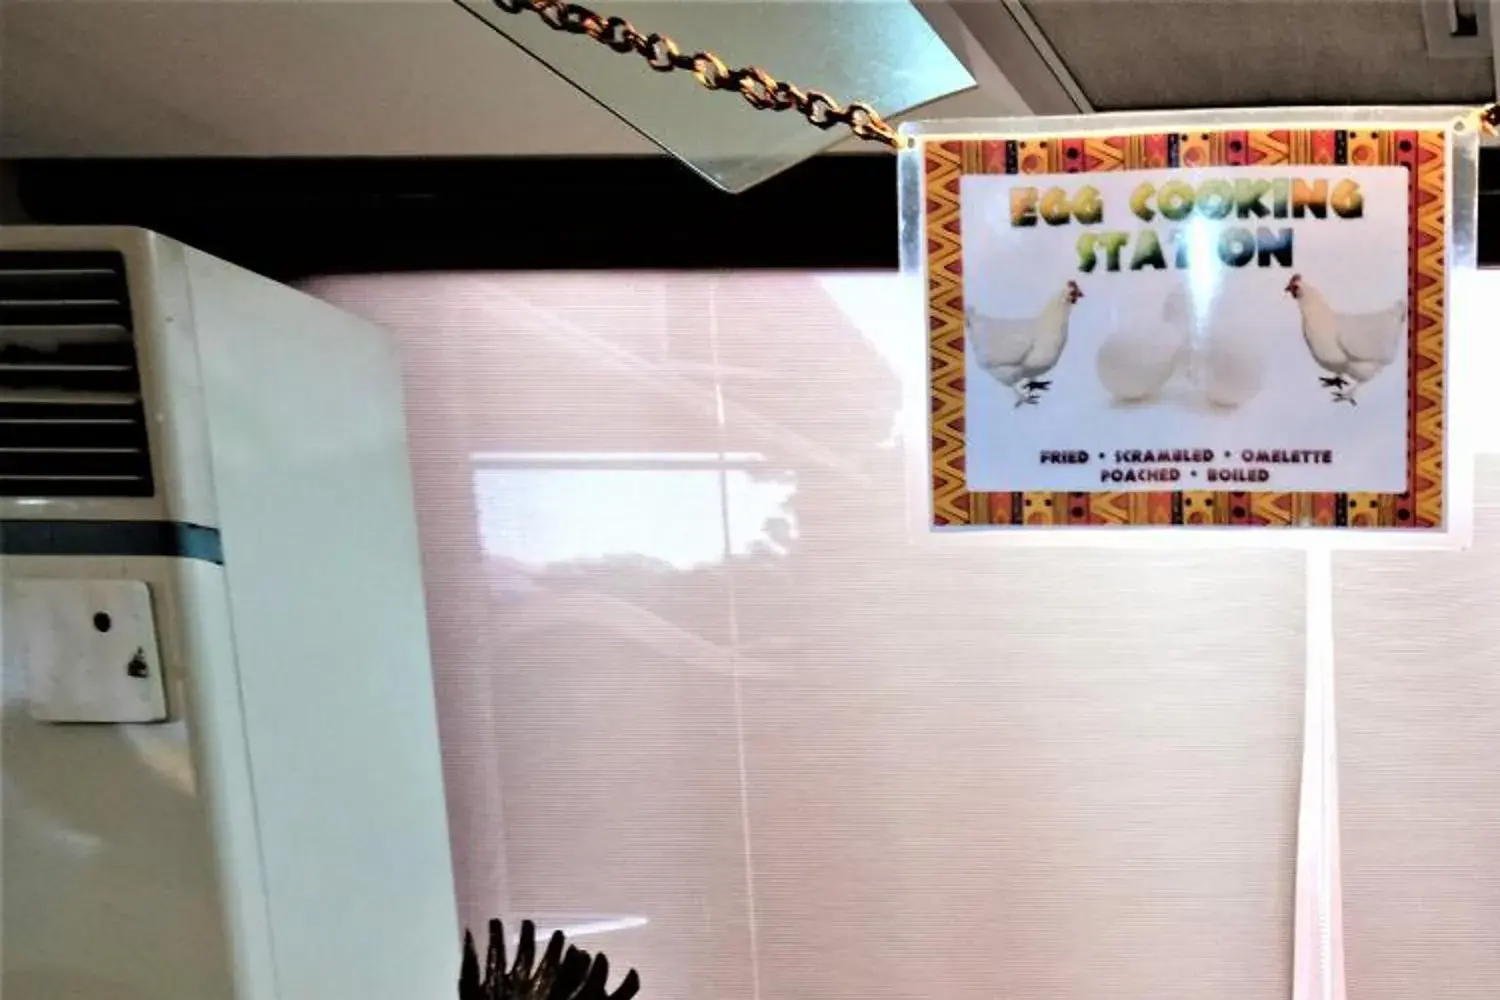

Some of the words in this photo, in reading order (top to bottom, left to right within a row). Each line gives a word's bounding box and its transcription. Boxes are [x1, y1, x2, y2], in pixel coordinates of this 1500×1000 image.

[1010, 185, 1103, 226] EGG
[1130, 177, 1364, 222] COOKING
[1076, 227, 1294, 273] STATON
[1040, 450, 1089, 464] FRIED
[1115, 449, 1214, 463] SCRAMBLED
[1241, 449, 1333, 463] OMELETTE
[1101, 468, 1181, 482] POACHED
[1207, 469, 1270, 482] BOILED
